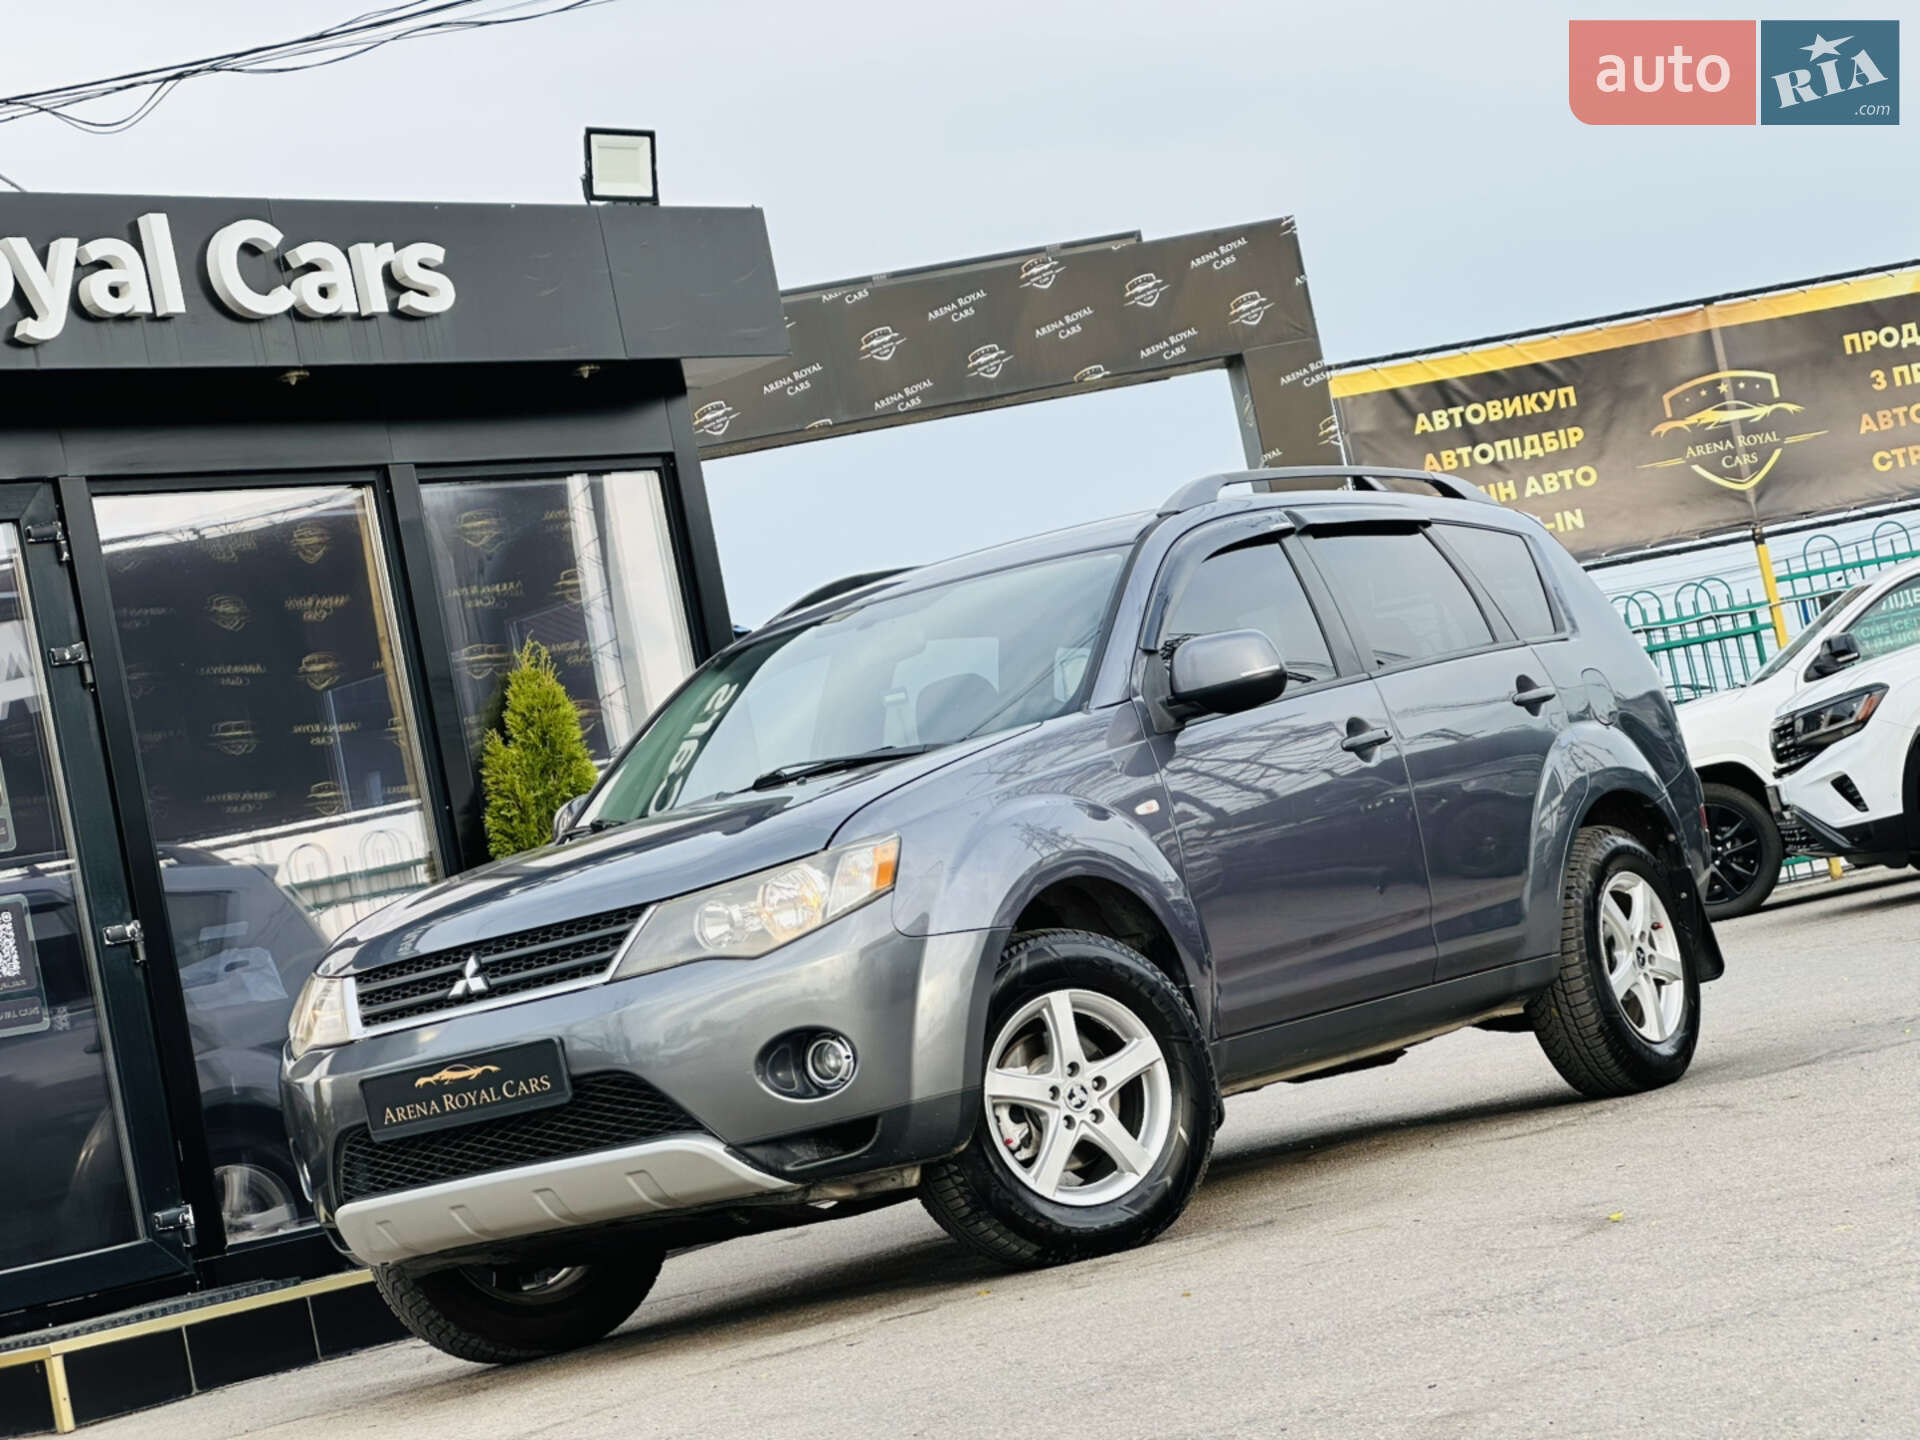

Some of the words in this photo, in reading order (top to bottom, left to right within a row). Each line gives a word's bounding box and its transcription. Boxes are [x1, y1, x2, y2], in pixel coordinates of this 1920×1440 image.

[1191, 250, 1219, 269] ARENA
[1218, 236, 1248, 255] ROYAL
[1212, 253, 1236, 270] CARS
[0, 213, 186, 344] yal
[206, 219, 456, 319] Cars
[928, 302, 958, 321] ARENA
[957, 289, 987, 308] ROYAL
[951, 306, 976, 322] CARS
[1035, 319, 1065, 338] ARENA
[1064, 306, 1094, 324] ROYAL
[1058, 323, 1082, 339] CARS
[1140, 340, 1169, 359] ARENA
[1168, 327, 1198, 345] ROYAL
[1162, 344, 1186, 360] CARS
[763, 376, 794, 395] ARENA
[793, 362, 823, 381] ROYAL
[787, 380, 811, 396] CARS
[874, 392, 904, 411] ARENA
[903, 378, 934, 397] ROYAL
[897, 395, 922, 411] CARS
[1414, 386, 1577, 435] АВТОВИКУП
[1424, 426, 1585, 473] АВТОПІДБІР
[1686, 439, 1734, 468] ARENA
[1736, 431, 1781, 449] ROYAL
[1721, 452, 1758, 469] CARS
[1525, 465, 1597, 498] АВТО
[1543, 508, 1585, 533] -IN
[383, 1100, 441, 1125] ARENA
[443, 1087, 501, 1112] ROYAL
[502, 1074, 552, 1099] CARS
